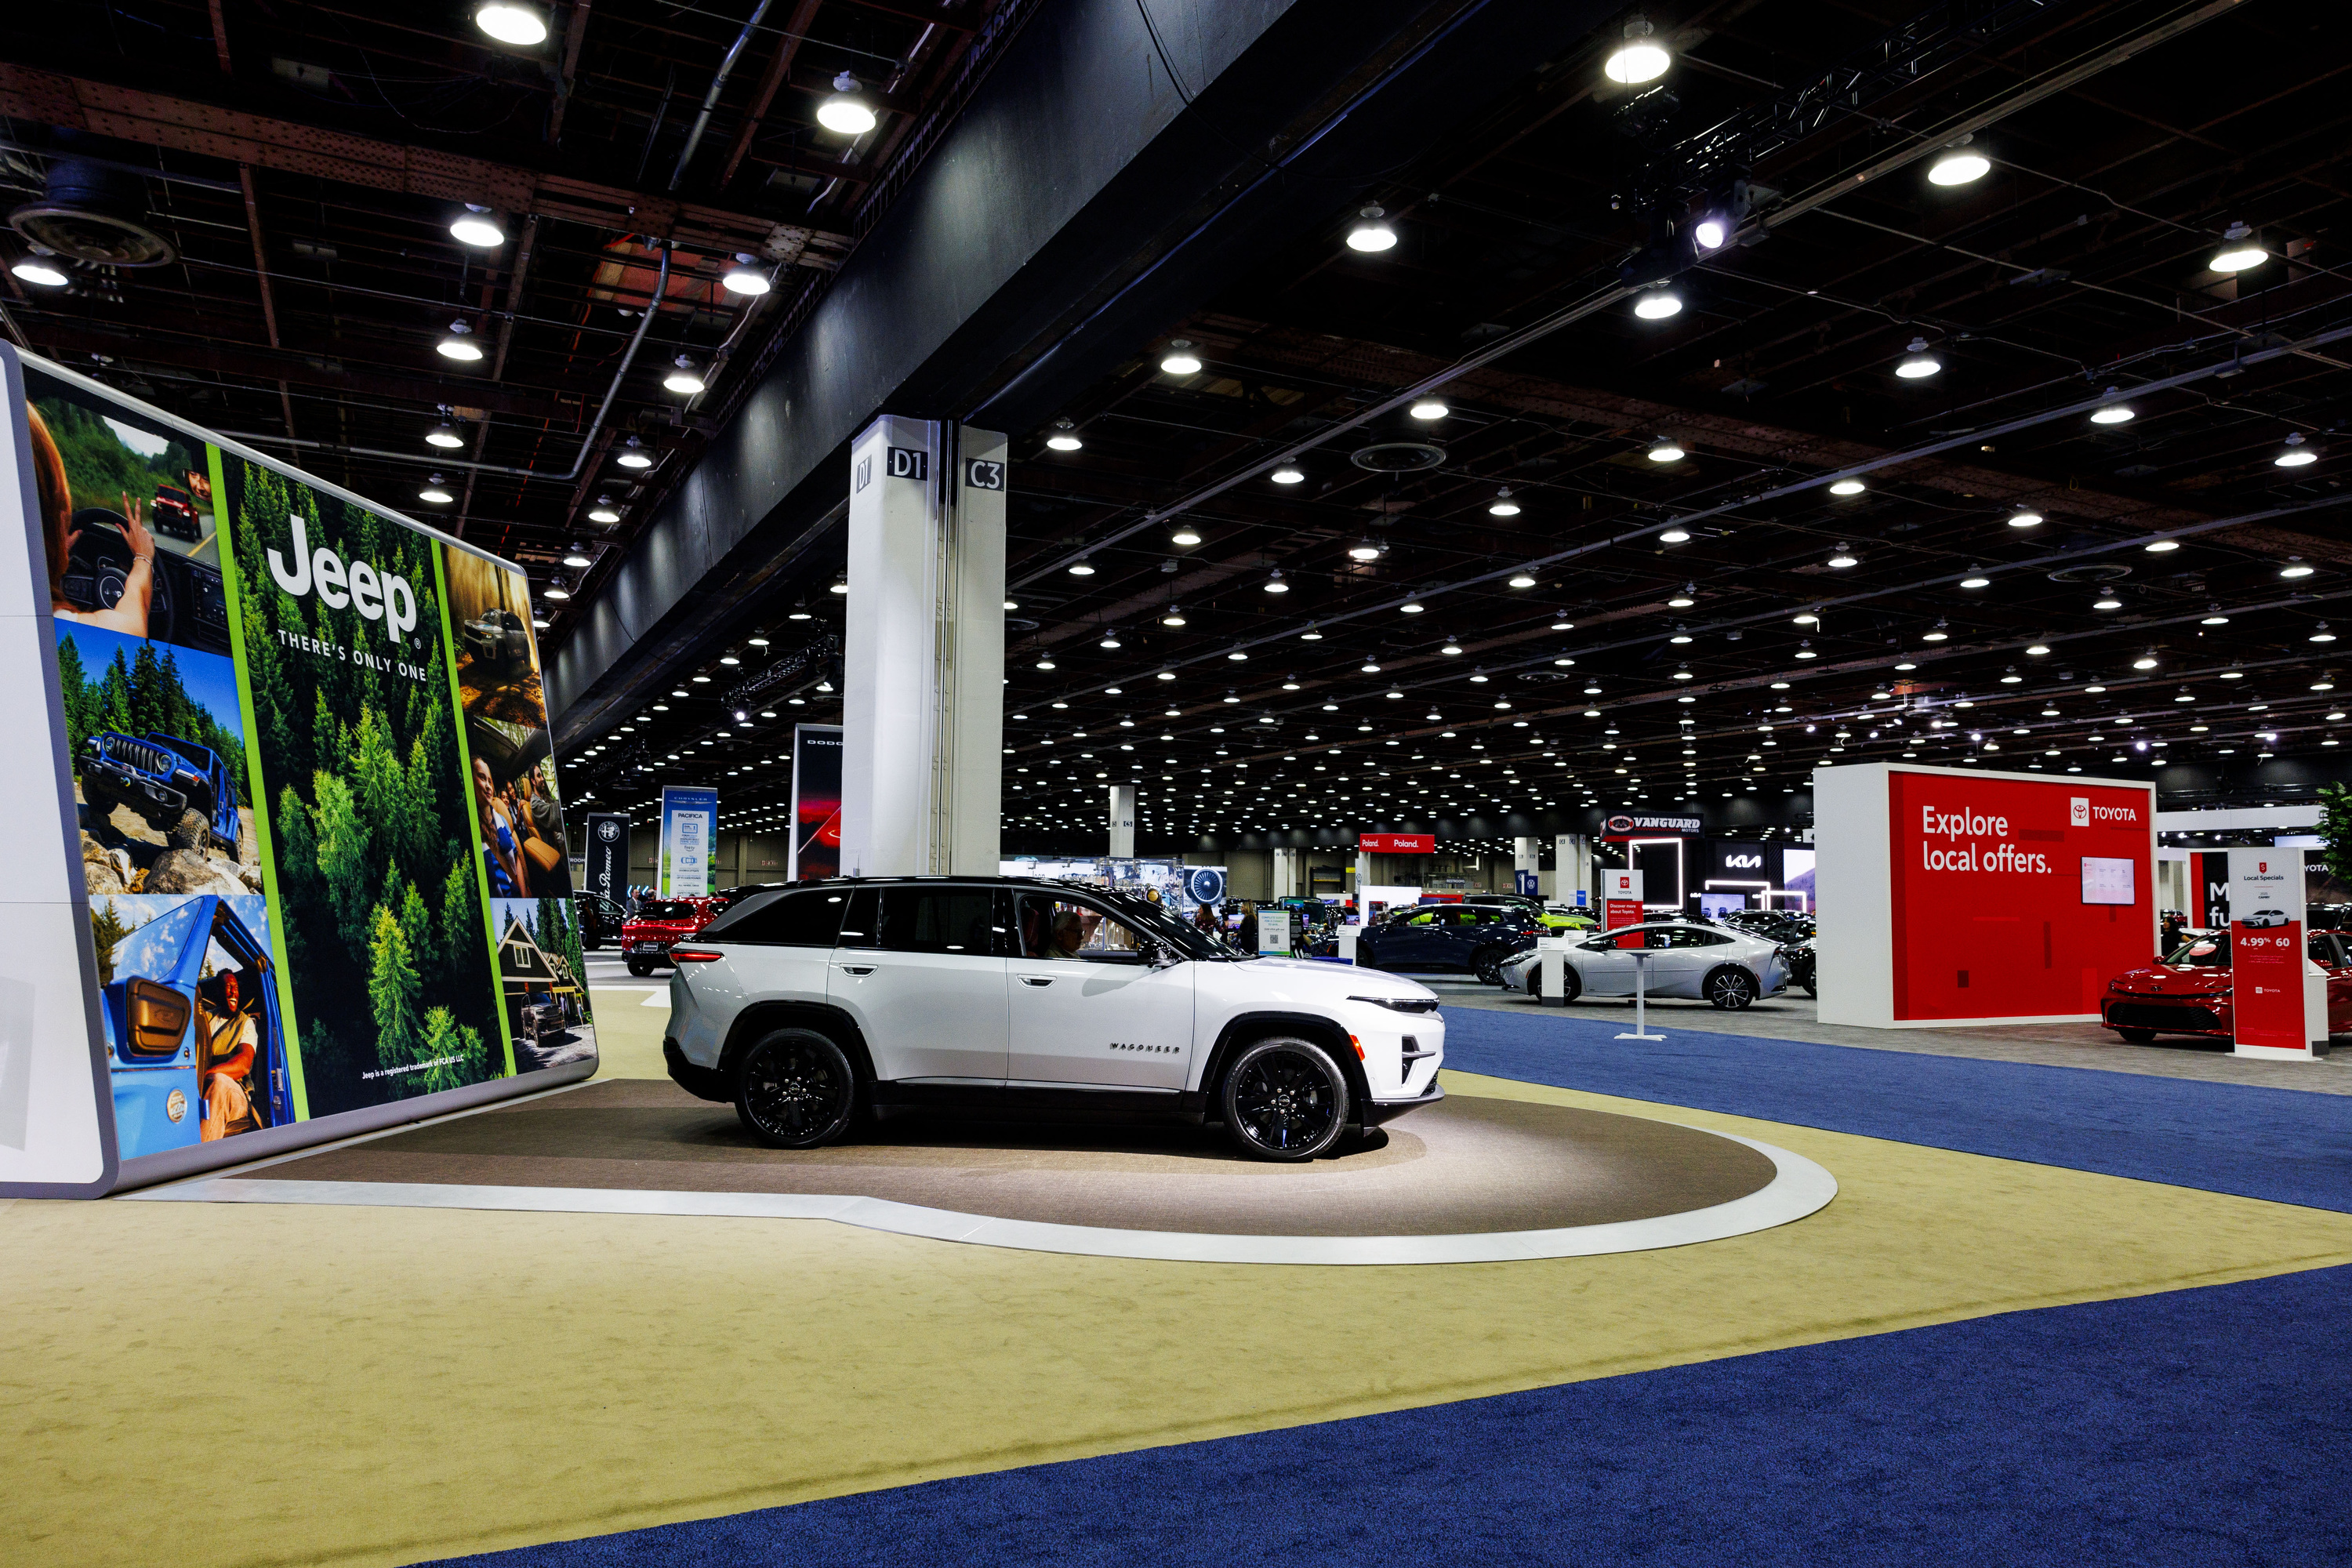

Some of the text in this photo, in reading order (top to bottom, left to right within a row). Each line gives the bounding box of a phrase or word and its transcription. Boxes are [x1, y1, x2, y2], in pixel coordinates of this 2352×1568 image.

[858, 459, 869, 490] D1
[894, 448, 921, 479] D1
[971, 461, 1000, 489] C3
[267, 514, 416, 643] Jeep
[278, 629, 426, 682] THERE'S ONLY ONE
[1633, 817, 1700, 829] VANGUARD
[1922, 805, 2009, 842] Explore
[2092, 807, 2136, 822] TOYOTA
[1394, 839, 1419, 848] Poland.
[1923, 841, 2052, 874] local offers.
[599, 846, 612, 888] Romeo
[1726, 854, 1762, 868] KIA
[2240, 937, 2290, 947] 4.99% 60
[1110, 1042, 1180, 1052] WAGONEER
[362, 1071, 375, 1080] Jeep
[385, 1064, 409, 1076] registered
[410, 1061, 433, 1071] trademark
